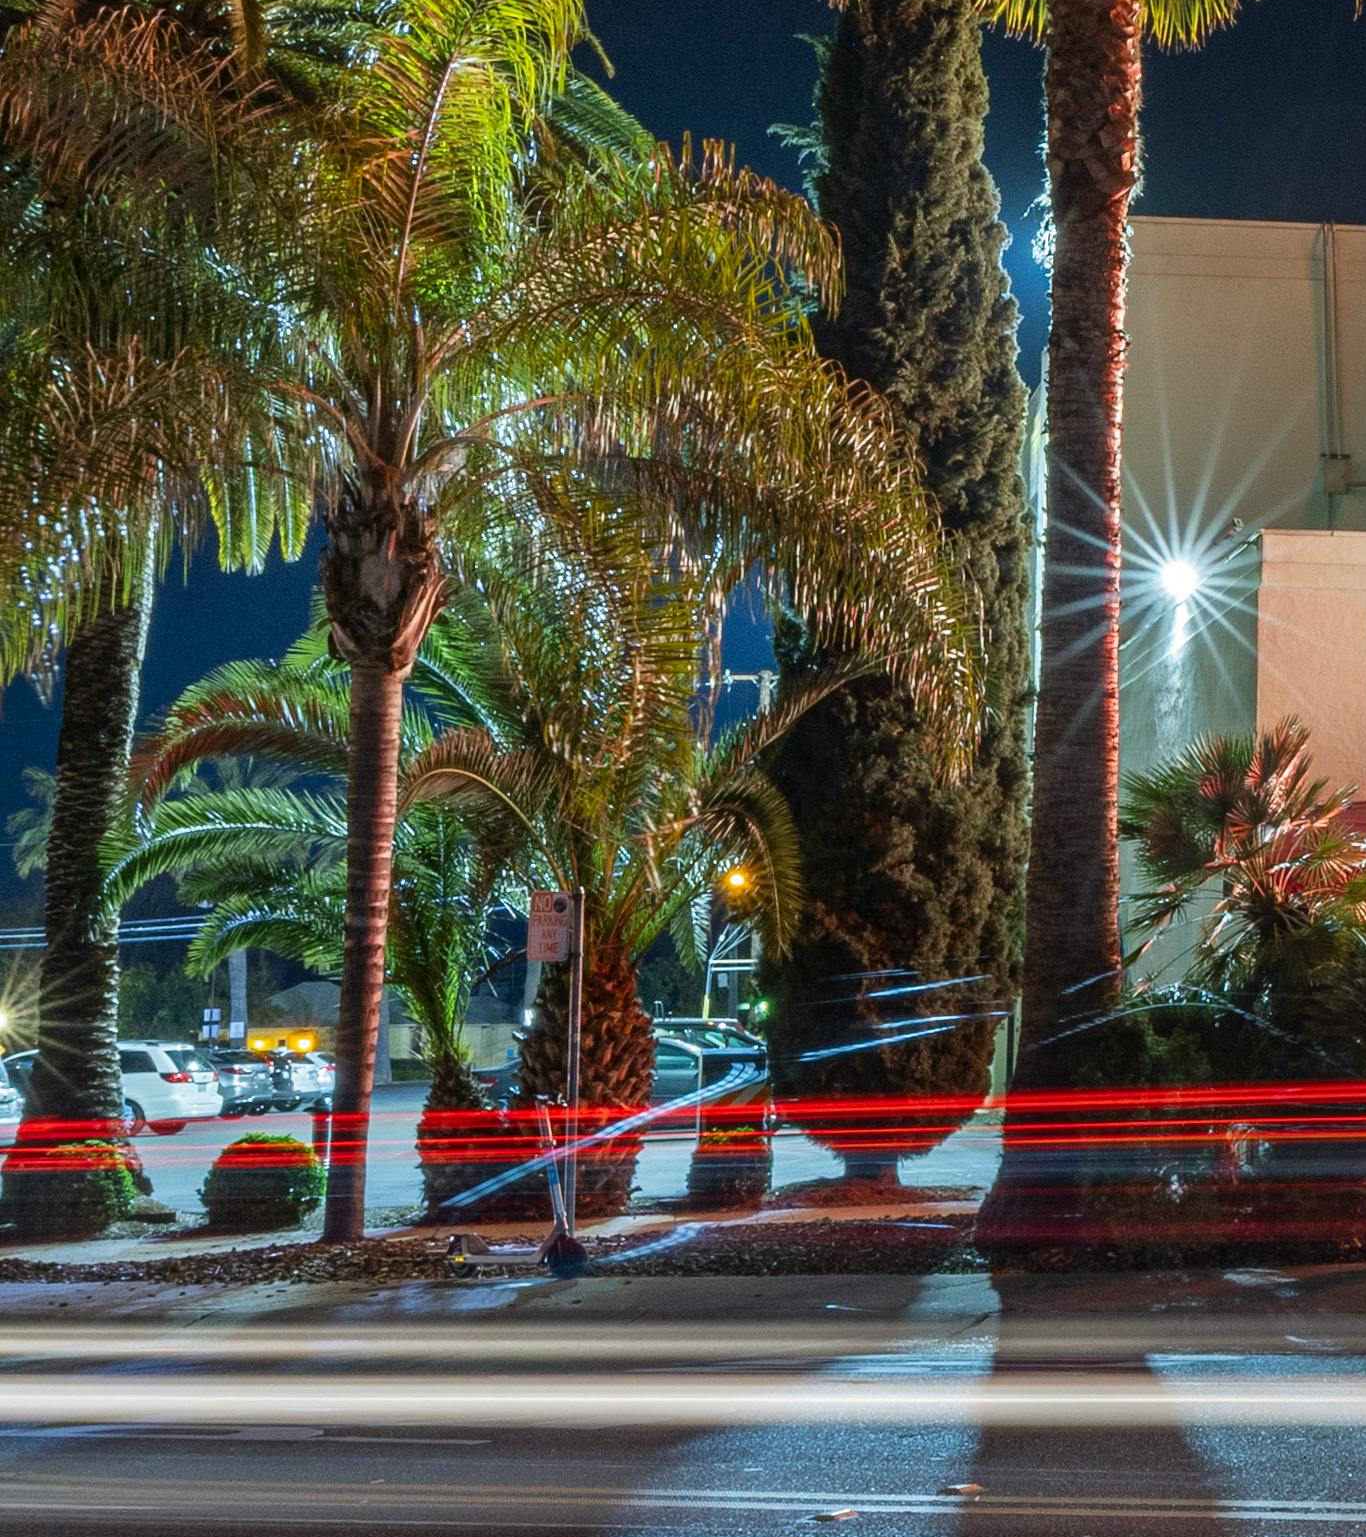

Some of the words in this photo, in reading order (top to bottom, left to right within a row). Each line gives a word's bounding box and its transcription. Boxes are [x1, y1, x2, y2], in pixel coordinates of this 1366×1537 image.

[533, 895, 552, 913] NO
[532, 914, 568, 927] PARKING
[541, 928, 557, 940] ANY
[538, 942, 559, 954] TIME
